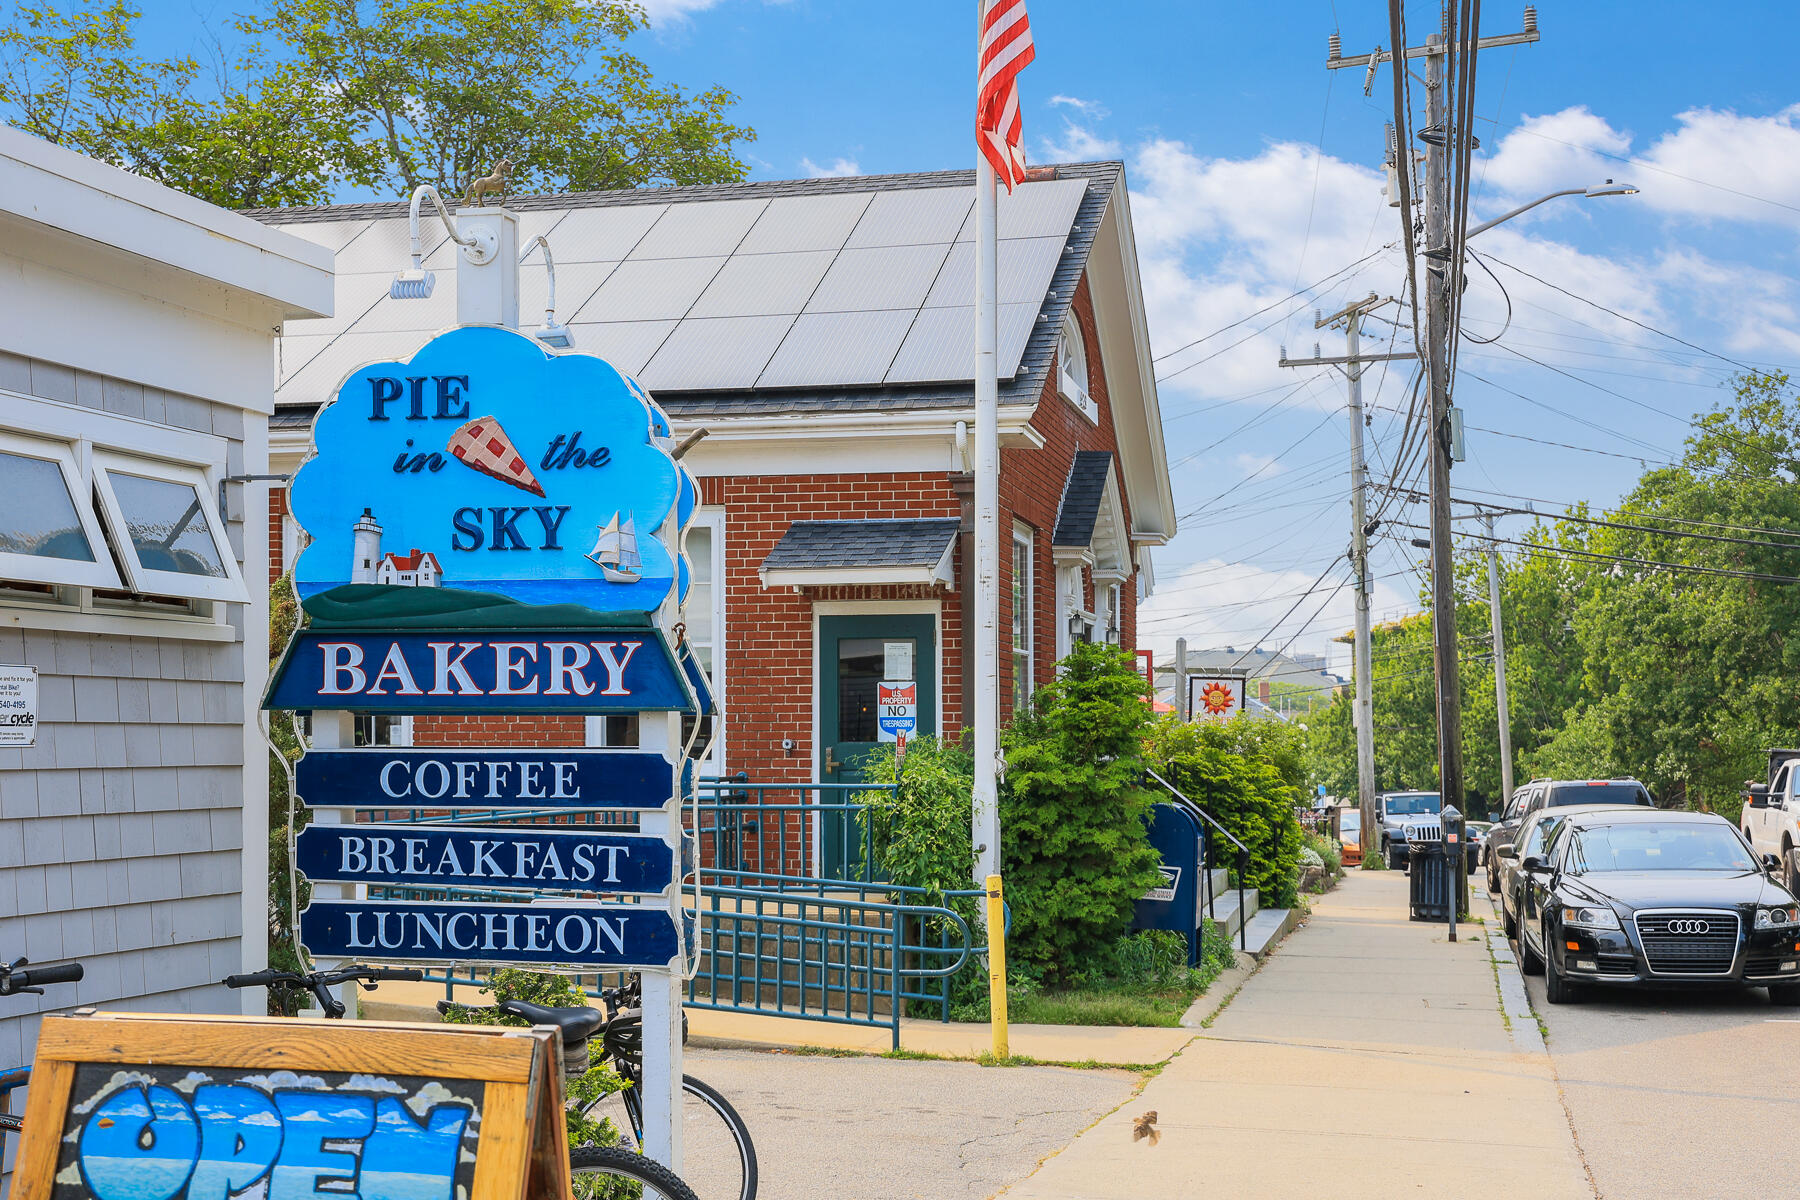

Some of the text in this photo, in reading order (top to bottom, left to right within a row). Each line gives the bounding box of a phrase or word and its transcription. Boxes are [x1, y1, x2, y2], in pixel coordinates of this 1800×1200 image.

[367, 375, 470, 421] PIE
[393, 430, 613, 475] in the
[452, 505, 572, 552] SKY
[317, 641, 642, 696] BAKERY
[10, 712, 34, 726] cycle
[882, 720, 913, 728] TRESPASSING
[888, 706, 906, 716] NO
[379, 760, 581, 799] COFFEE
[338, 836, 630, 883] BREAKFAST
[345, 911, 630, 955] LUNCHEON
[79, 1082, 473, 1200] OPEN
